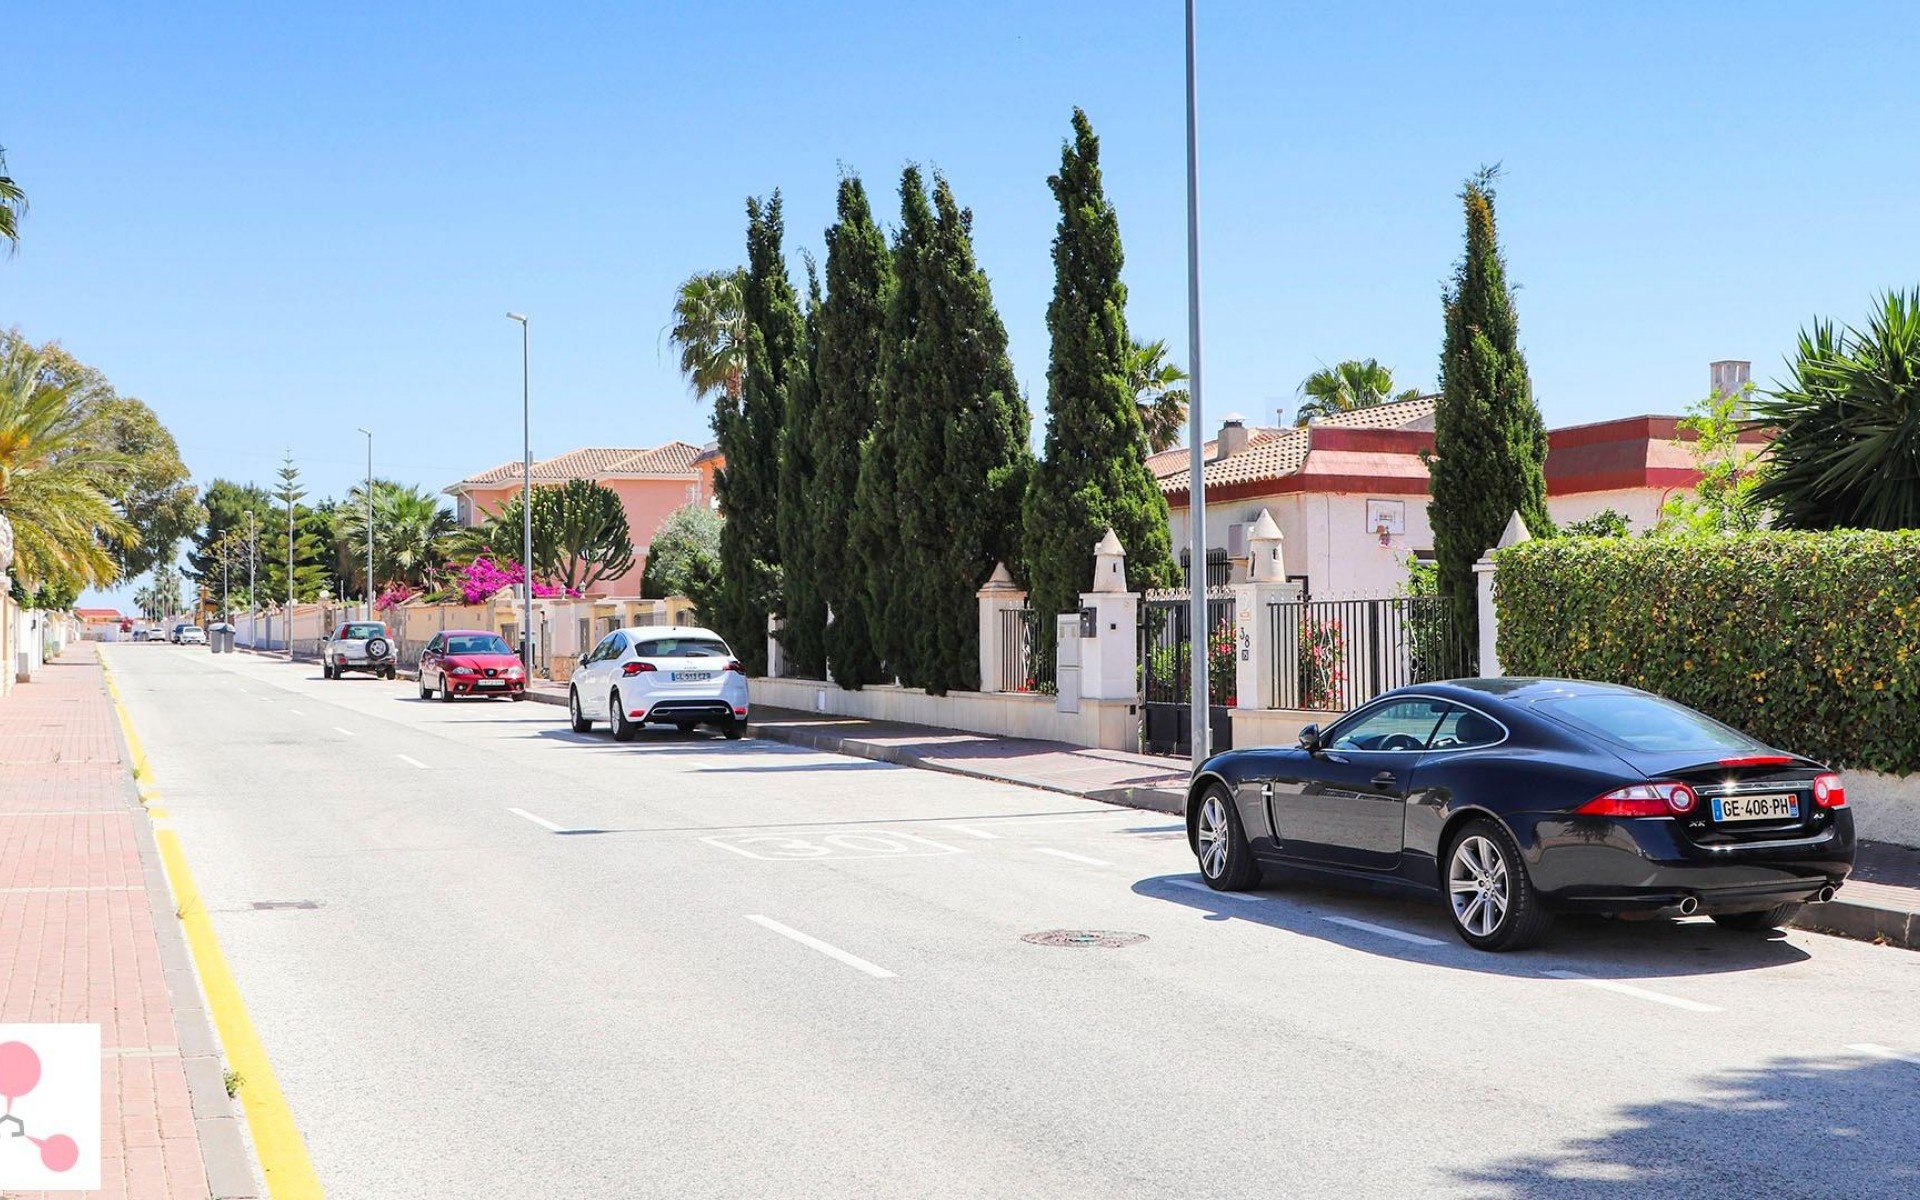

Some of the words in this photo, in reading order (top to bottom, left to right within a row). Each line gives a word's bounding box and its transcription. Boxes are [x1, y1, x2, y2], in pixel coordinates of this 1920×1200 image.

[1239, 627, 1250, 648] 38
[1723, 798, 1789, 817] GE-406-PH
[739, 836, 908, 855] 30
